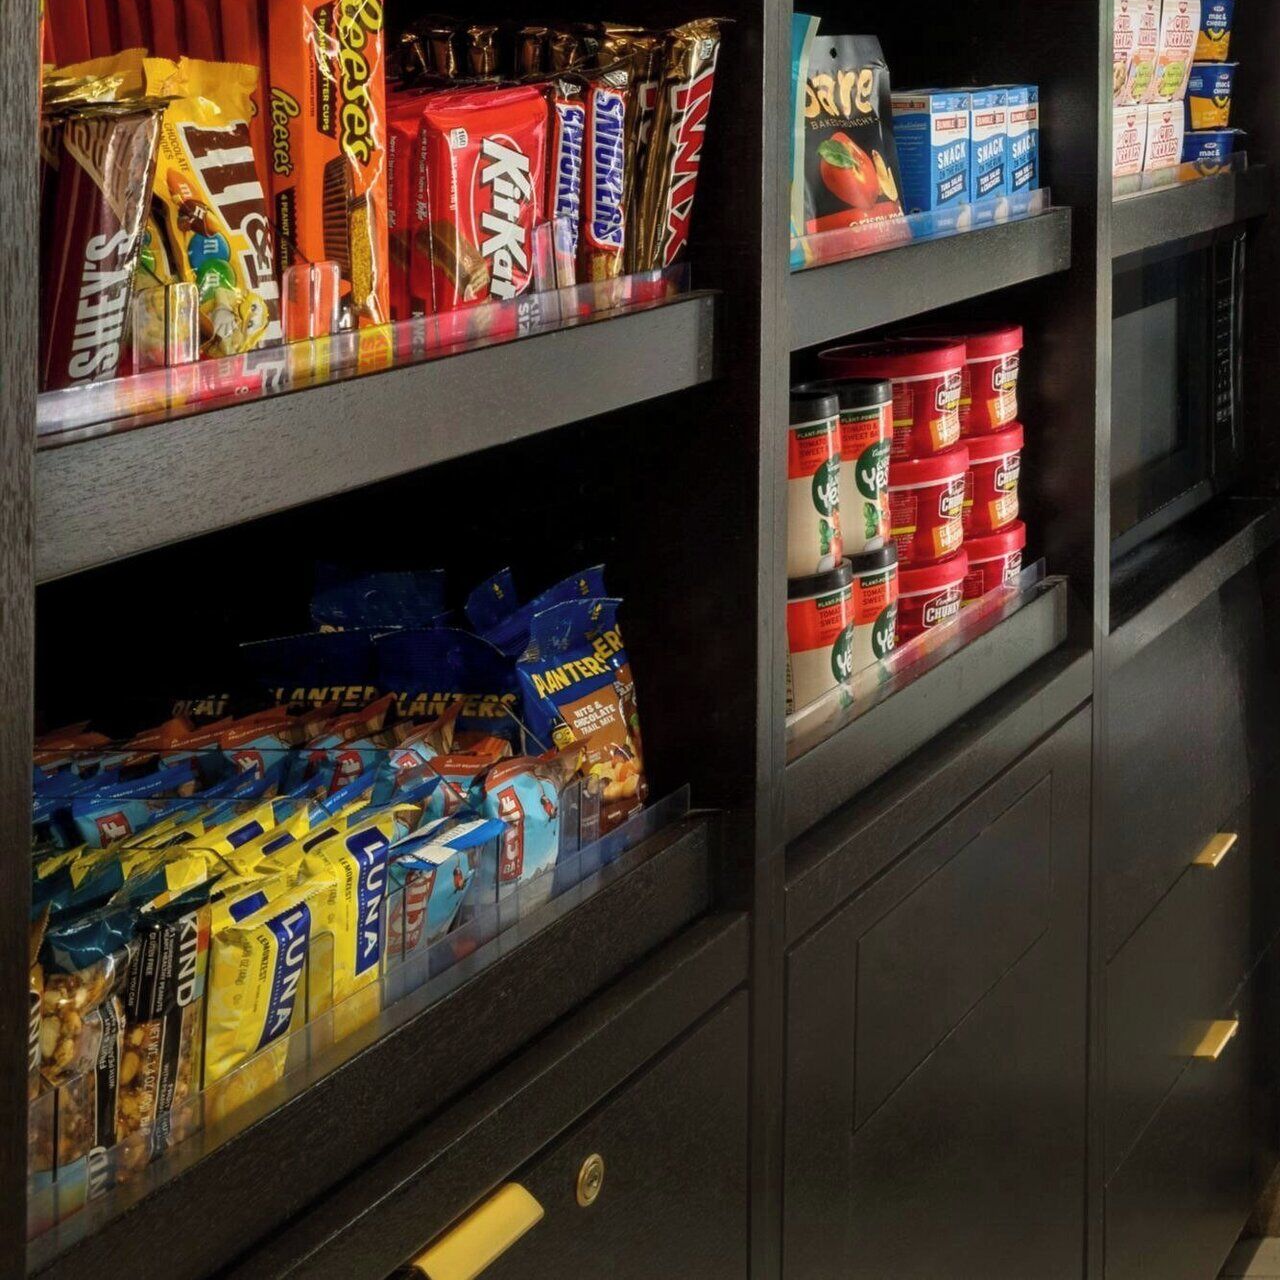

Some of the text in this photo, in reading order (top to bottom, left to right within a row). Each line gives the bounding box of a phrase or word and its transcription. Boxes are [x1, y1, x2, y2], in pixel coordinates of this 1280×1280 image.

[1166, 31, 1194, 48] NOODLES
[271, 87, 300, 177] Reese's
[1012, 132, 1036, 158] SNACK
[937, 142, 966, 170] SNACK
[977, 137, 1004, 164] SNACK
[1151, 139, 1179, 159] NOODLES
[595, 90, 625, 245] SNICKERS
[841, 422, 872, 435] TOMATO
[842, 431, 869, 443] SWEET
[600, 714, 616, 727] MIX
[361, 840, 386, 959] LUNA
[176, 910, 198, 1007] KIND
[268, 910, 305, 1035] LUNA
